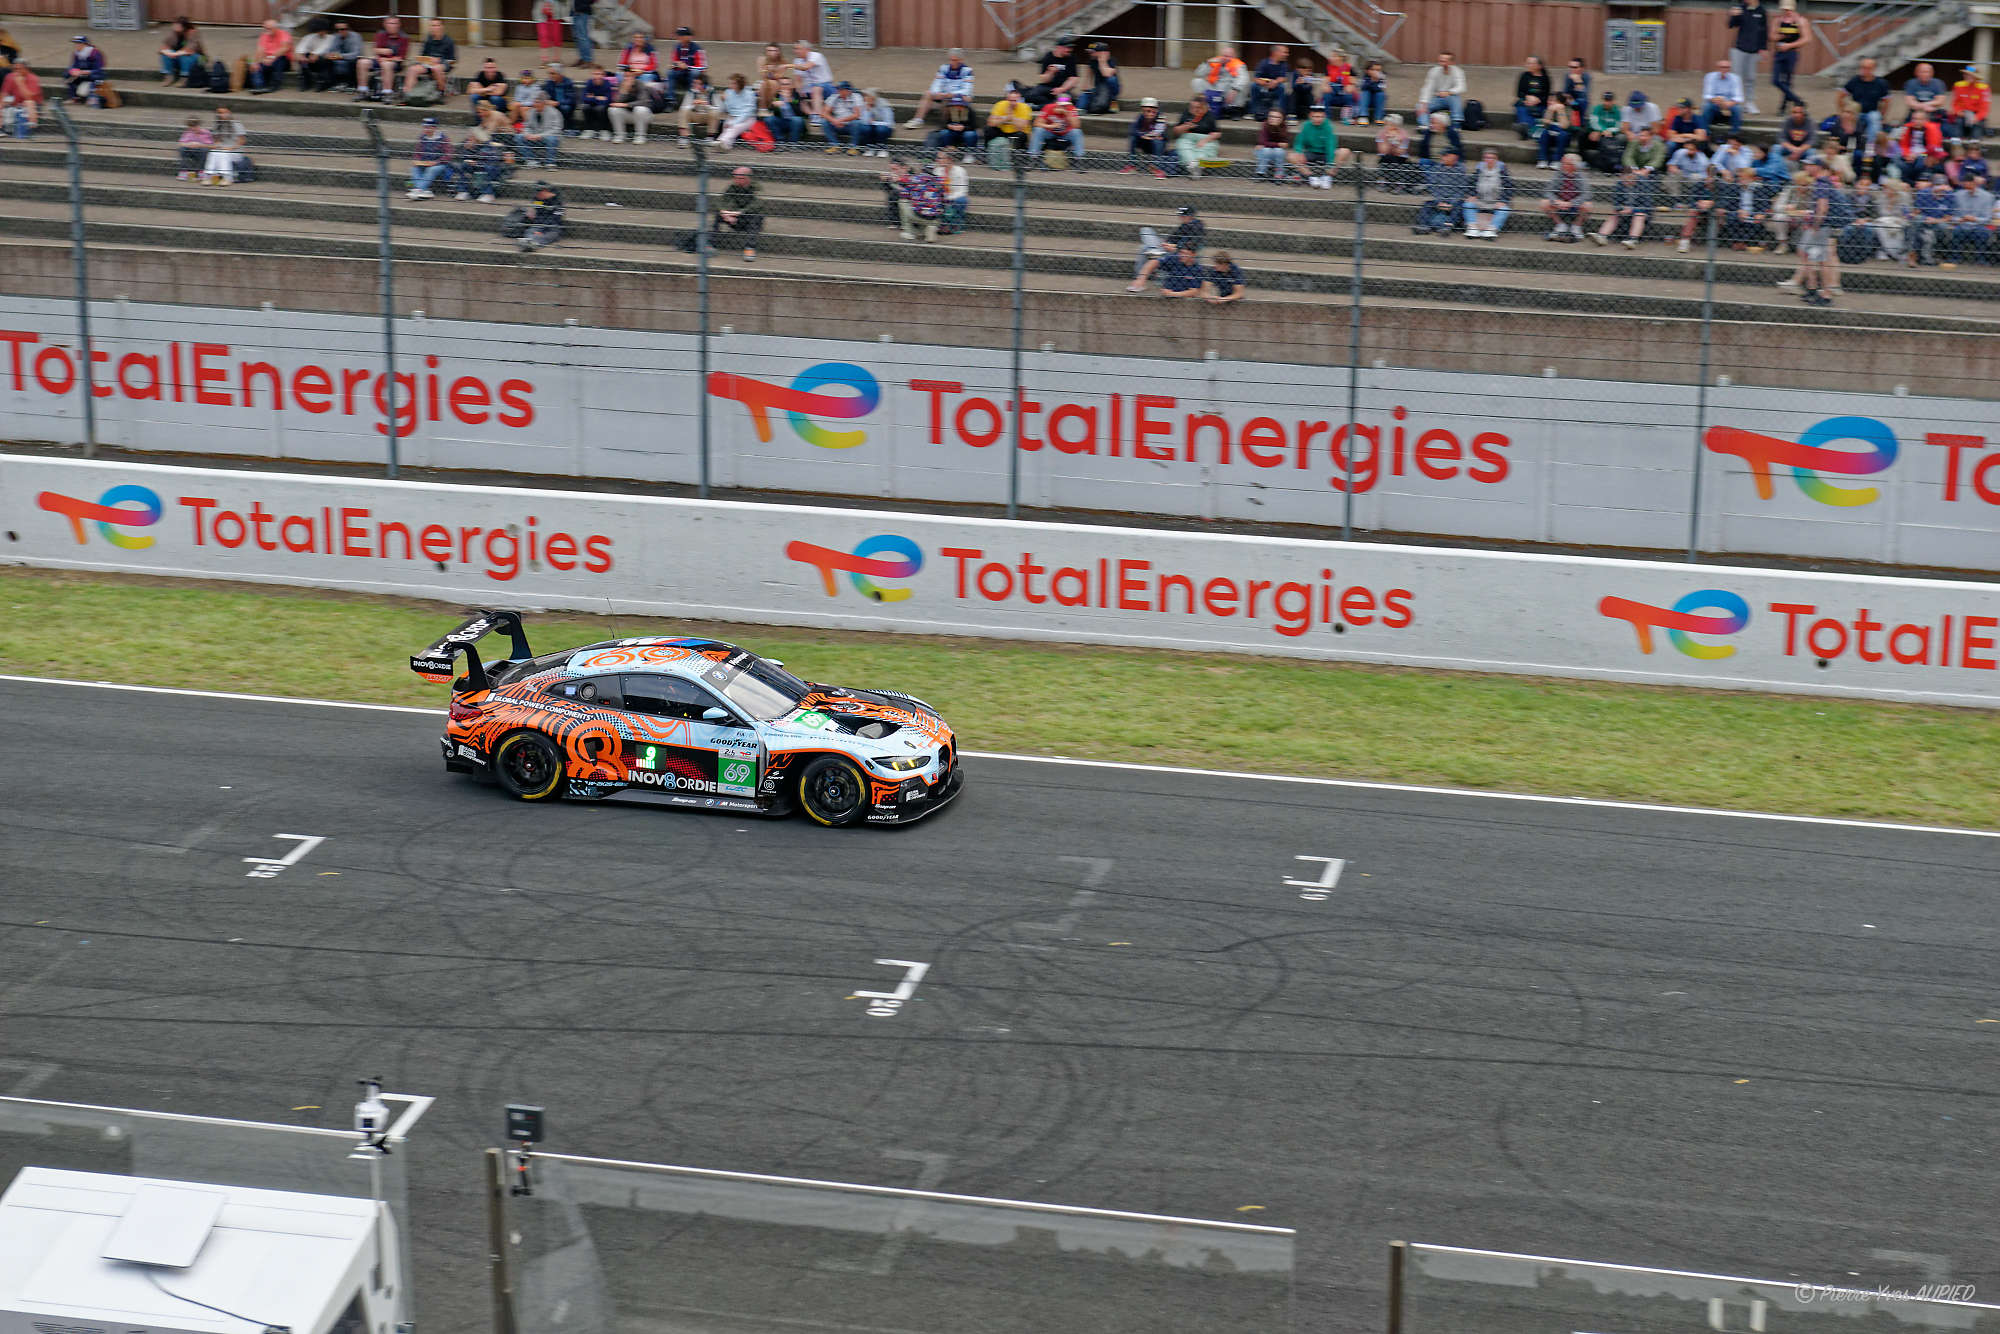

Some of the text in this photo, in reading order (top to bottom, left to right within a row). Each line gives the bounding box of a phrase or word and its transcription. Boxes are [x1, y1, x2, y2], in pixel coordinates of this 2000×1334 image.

[0, 329, 535, 438] TotalEnergies
[908, 378, 1511, 494] TotalEnergies
[178, 496, 613, 582] TotalEnergies
[940, 547, 1414, 637] TotalEnergies
[1768, 602, 2000, 671] TotalE
[494, 695, 594, 721] GLOBAL POWER COMPONENTS
[710, 737, 758, 749] GOODYEAR
[723, 762, 751, 783] 69
[627, 769, 718, 793] INOV8ORDIE
